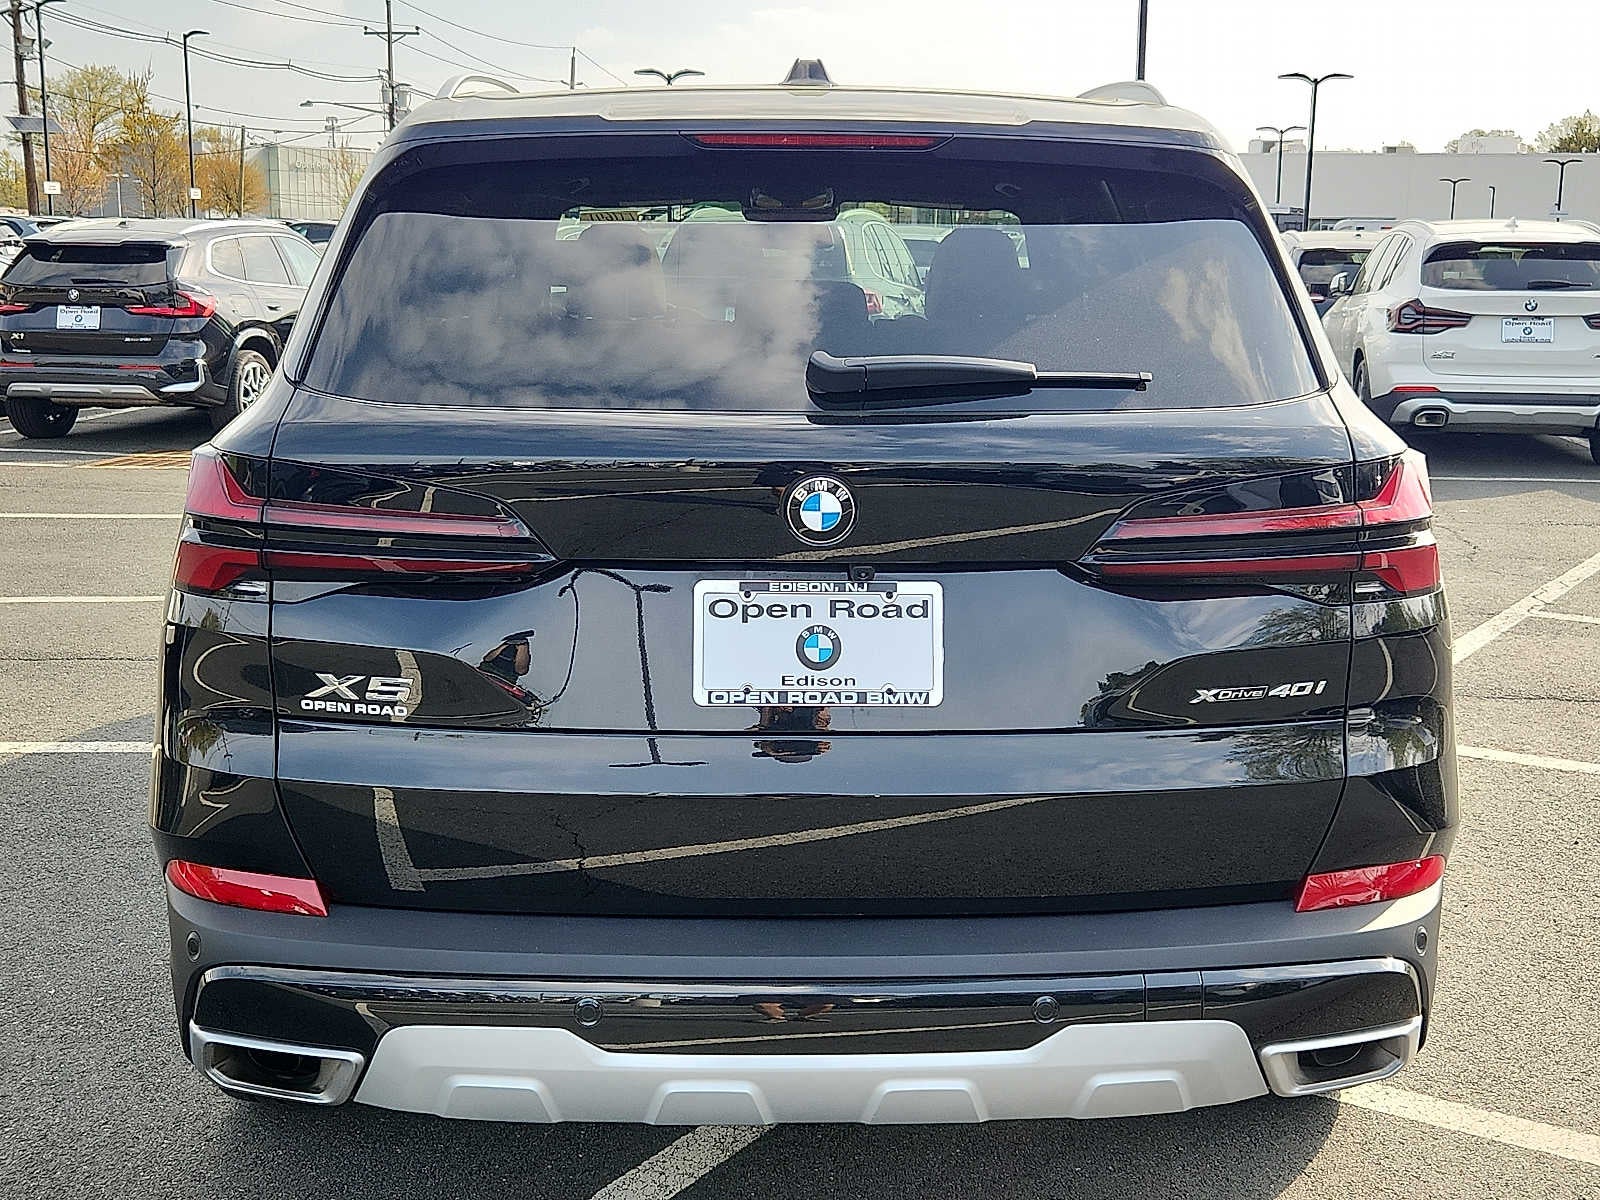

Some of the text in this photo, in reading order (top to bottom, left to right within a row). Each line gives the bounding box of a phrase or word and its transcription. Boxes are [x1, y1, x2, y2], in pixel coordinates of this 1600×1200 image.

[794, 480, 849, 502] BMW
[768, 582, 868, 592] EDISON, NJ
[708, 598, 929, 624] Open Road
[801, 625, 838, 640] BMW
[304, 672, 414, 702] X5
[781, 675, 856, 687] Edison
[710, 691, 928, 704] OPEN ROAD BMW
[300, 699, 408, 717] OPEN ROAD
